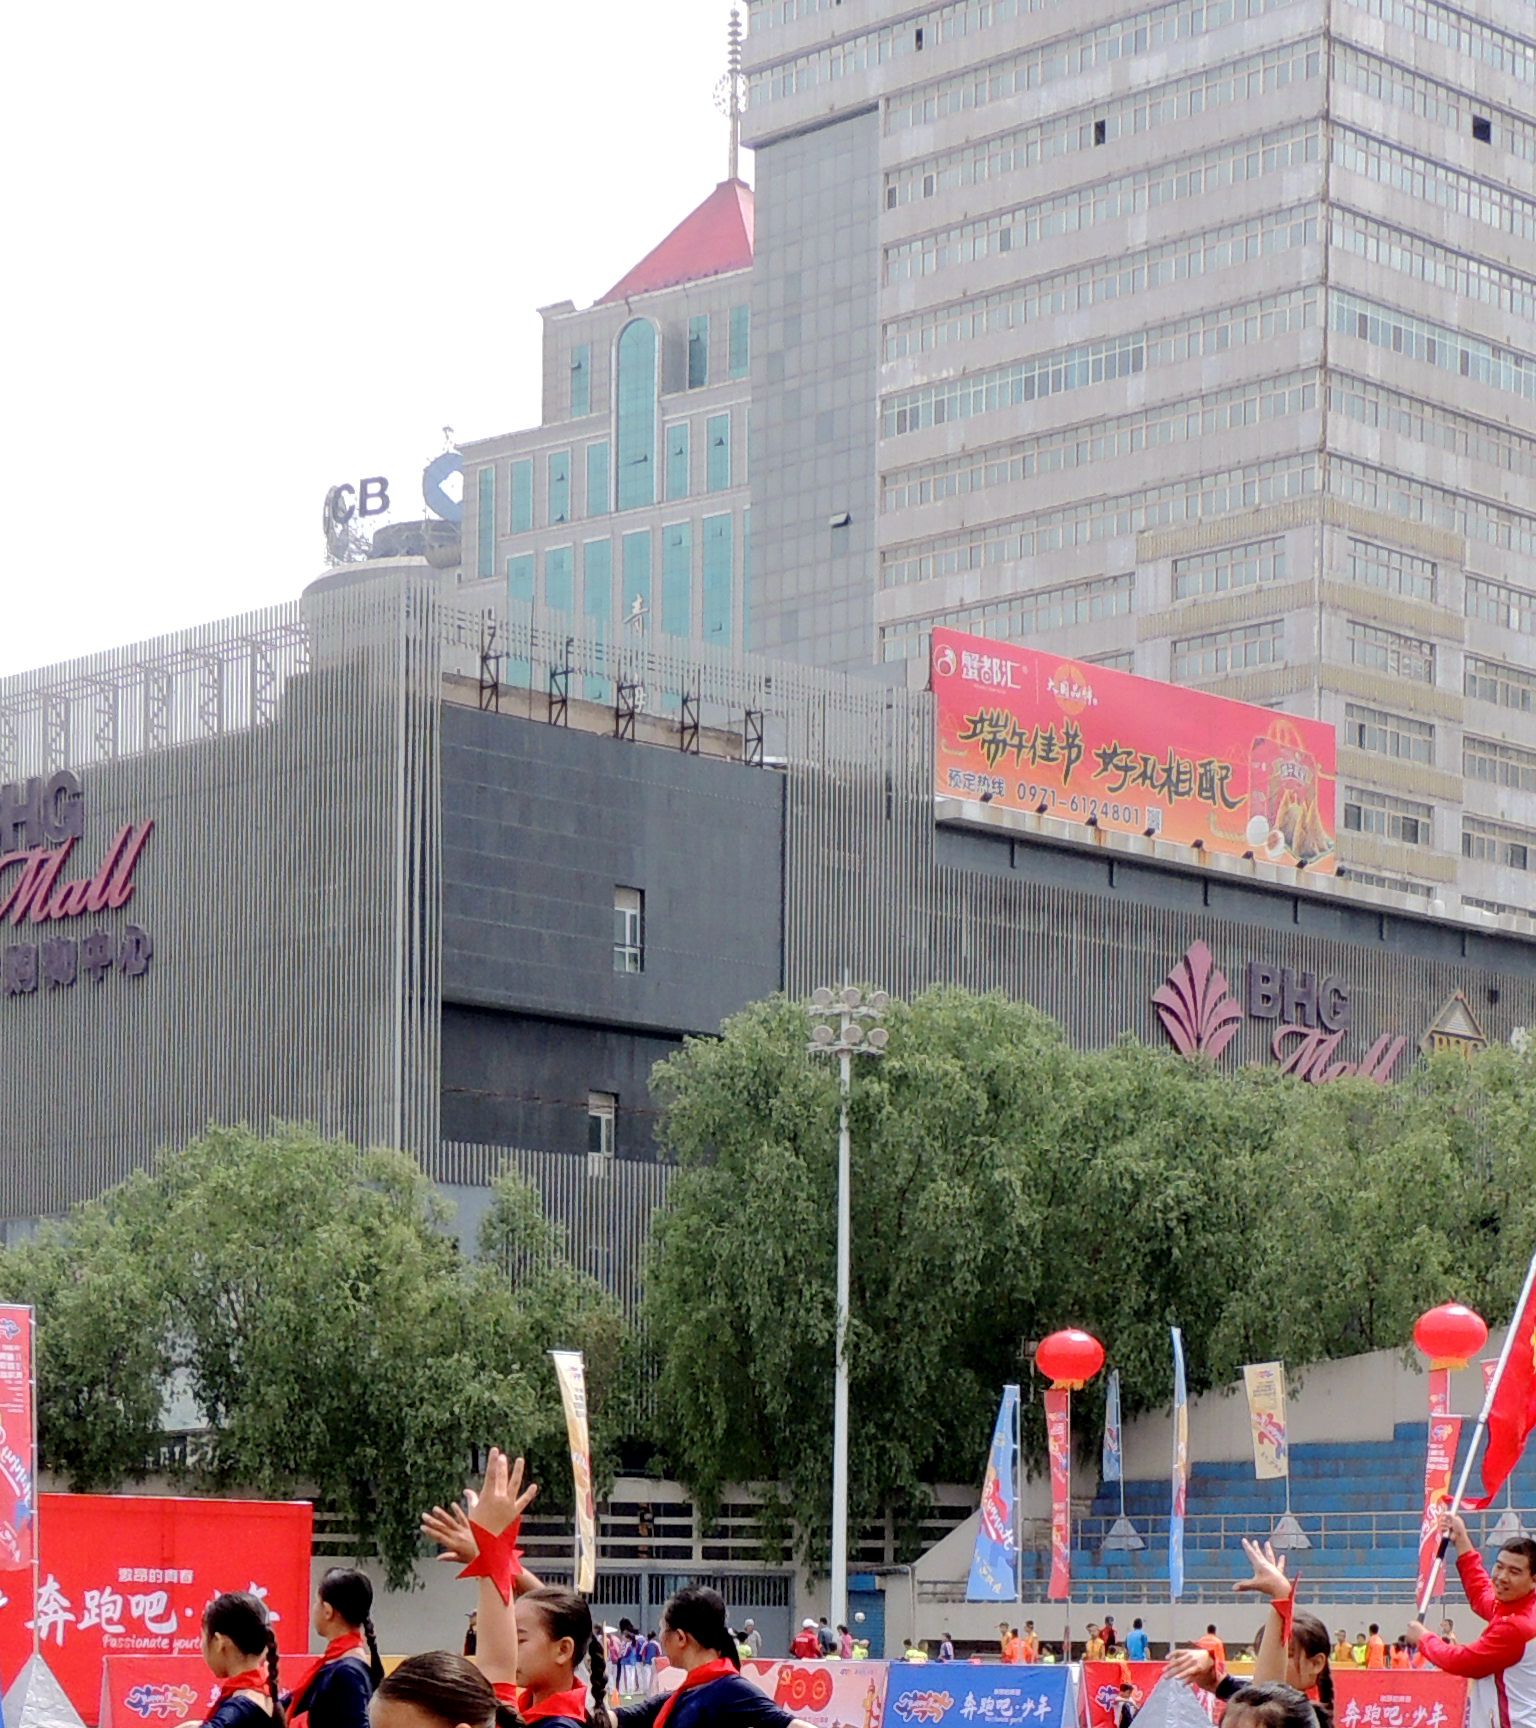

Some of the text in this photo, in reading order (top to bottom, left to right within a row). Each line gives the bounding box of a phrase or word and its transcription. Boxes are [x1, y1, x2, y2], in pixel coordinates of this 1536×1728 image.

[961, 650, 1021, 690] 蟹都汇
[959, 708, 1085, 787] 端午佳节
[948, 768, 1141, 826] 预定热线 0971-6124801
[1249, 962, 1351, 1032] BHG
[102, 1633, 169, 1650] Passionate
[960, 1691, 1052, 1722] 奔跑吧·少年
